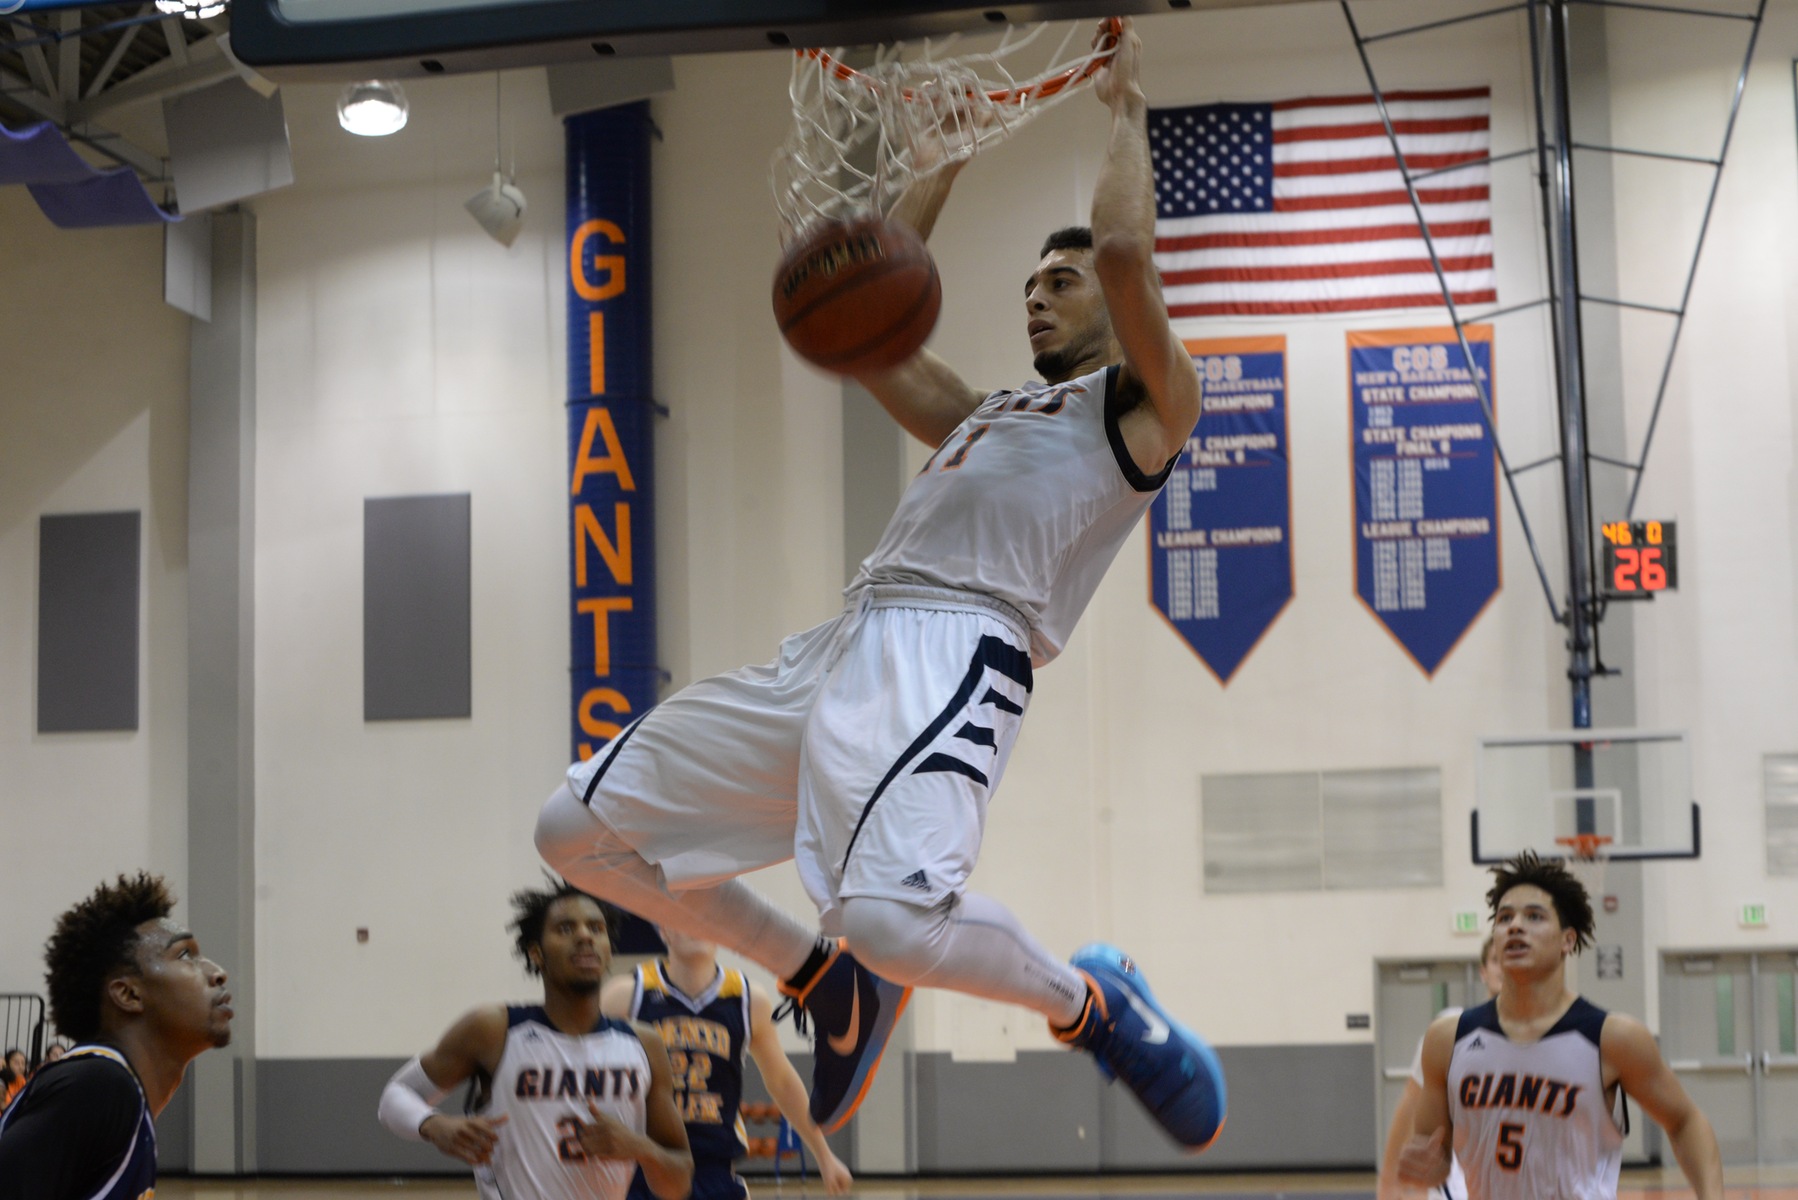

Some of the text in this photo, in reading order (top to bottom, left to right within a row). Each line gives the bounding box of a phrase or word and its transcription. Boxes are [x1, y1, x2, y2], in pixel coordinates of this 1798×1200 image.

[1392, 345, 1449, 372] COS
[1400, 367, 1487, 384] BASKETBAL
[1362, 386, 1406, 404] STATE
[1363, 427, 1406, 444] STATE
[570, 219, 636, 762] GIANTS
[1602, 521, 1632, 546] 46
[1614, 547, 1667, 592] 26
[1459, 1072, 1585, 1118] GIANTS
[1496, 1121, 1526, 1175] 5
